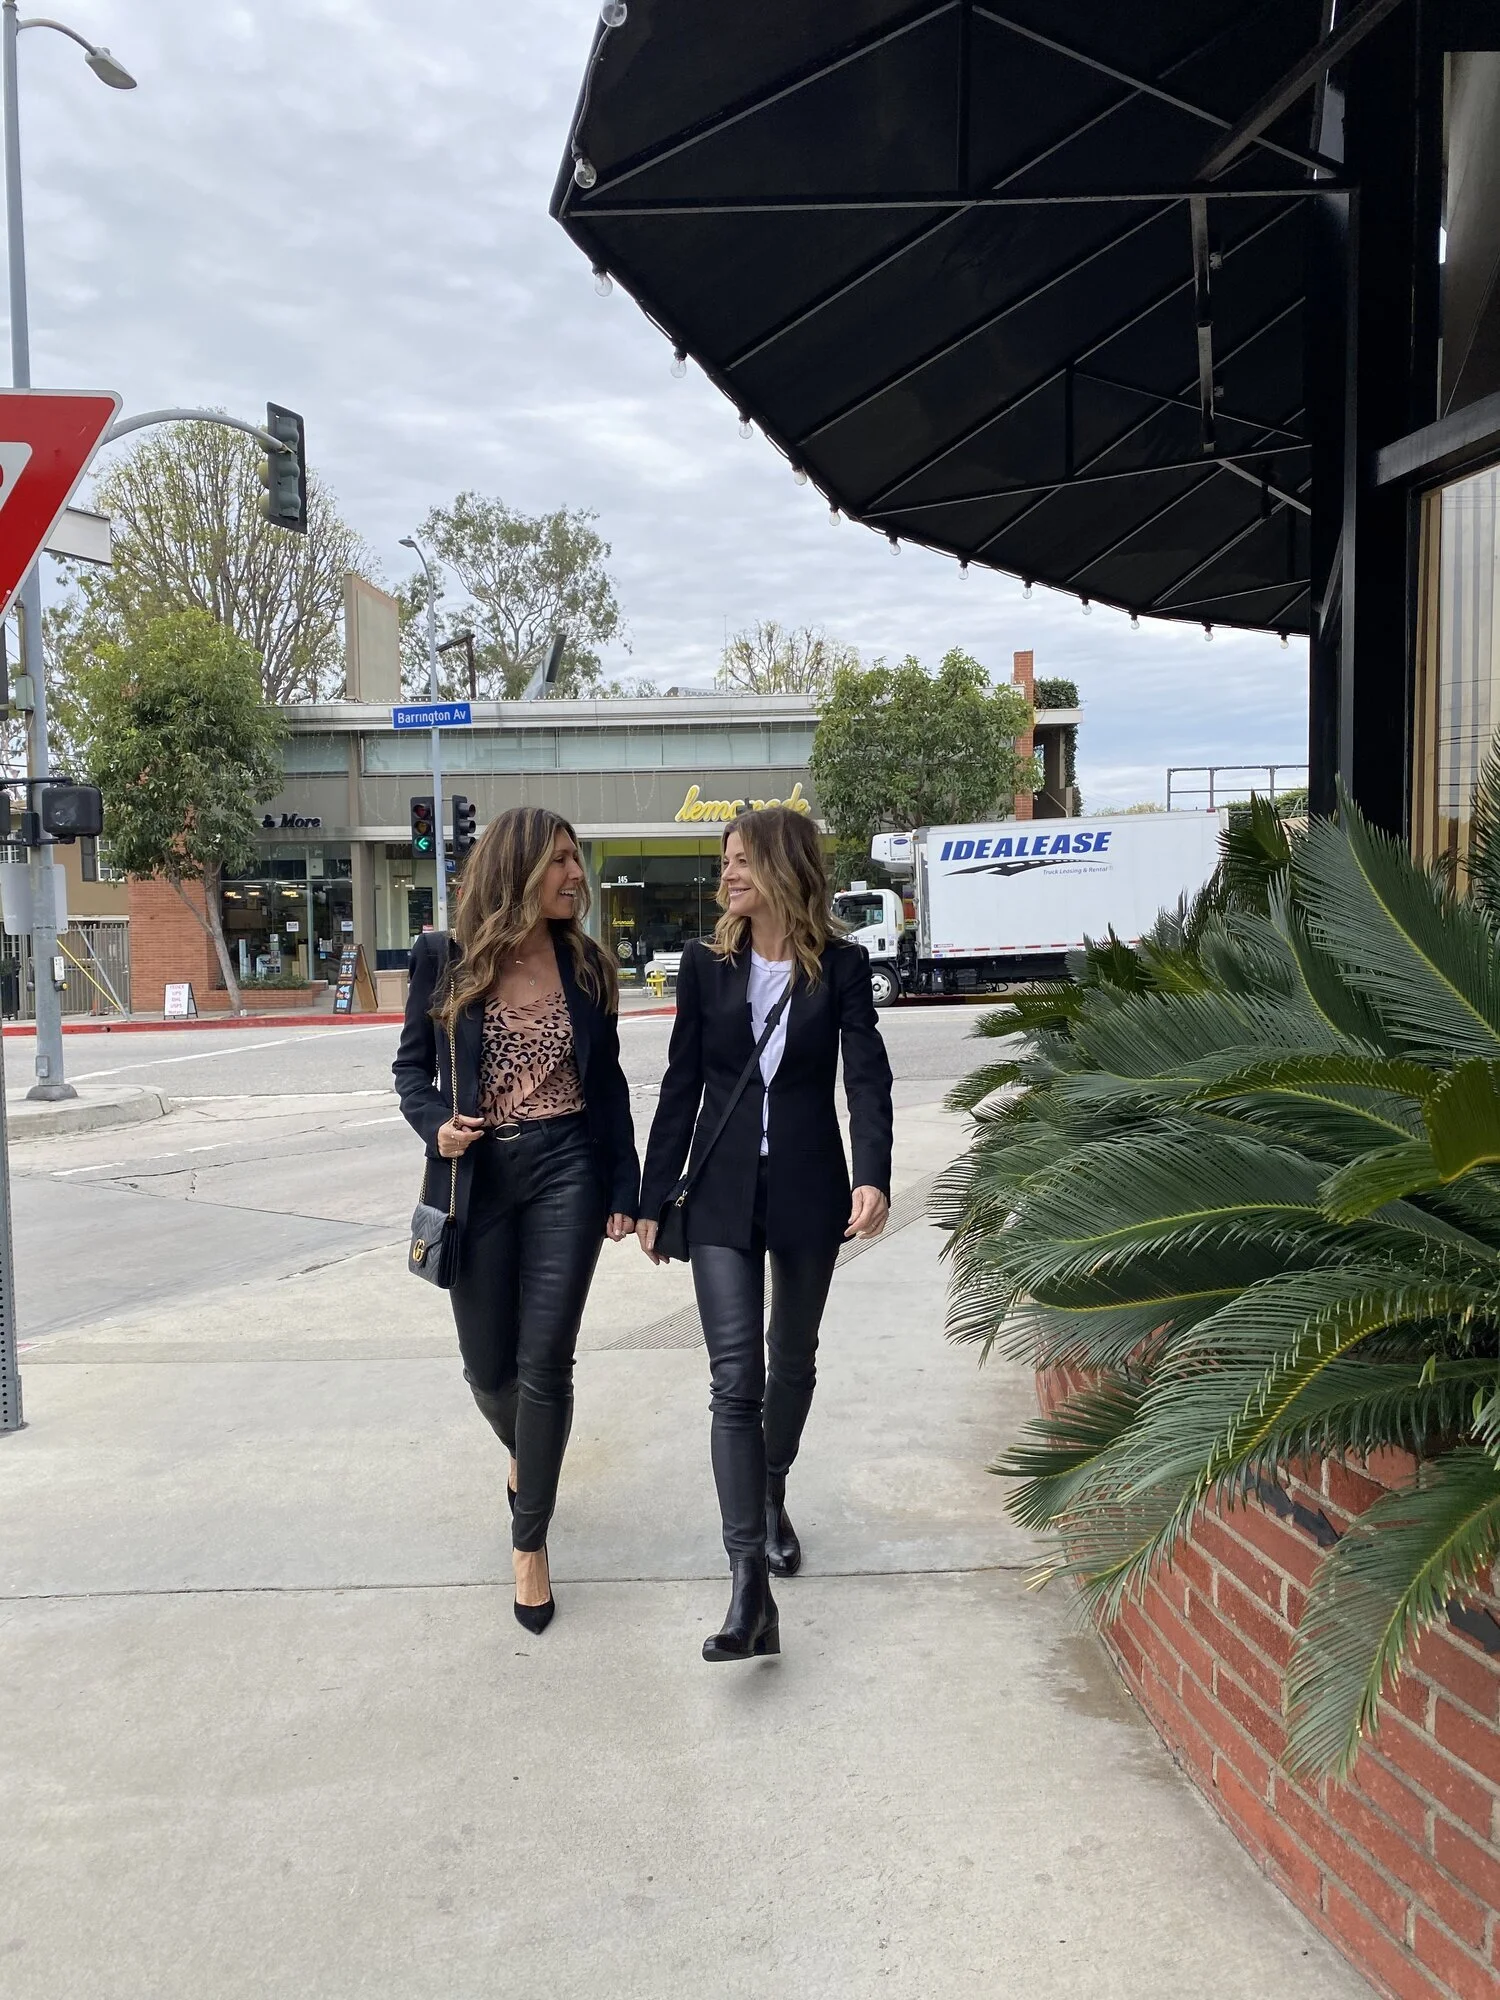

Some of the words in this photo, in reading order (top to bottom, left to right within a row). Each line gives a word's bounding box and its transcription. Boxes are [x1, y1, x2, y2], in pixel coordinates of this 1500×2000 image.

[397, 710, 451, 725] Barrington
[453, 708, 467, 720] Av
[262, 813, 275, 828] &
[279, 813, 321, 828] More
[940, 831, 1112, 862] IDEALEASE
[617, 875, 628, 884] 145
